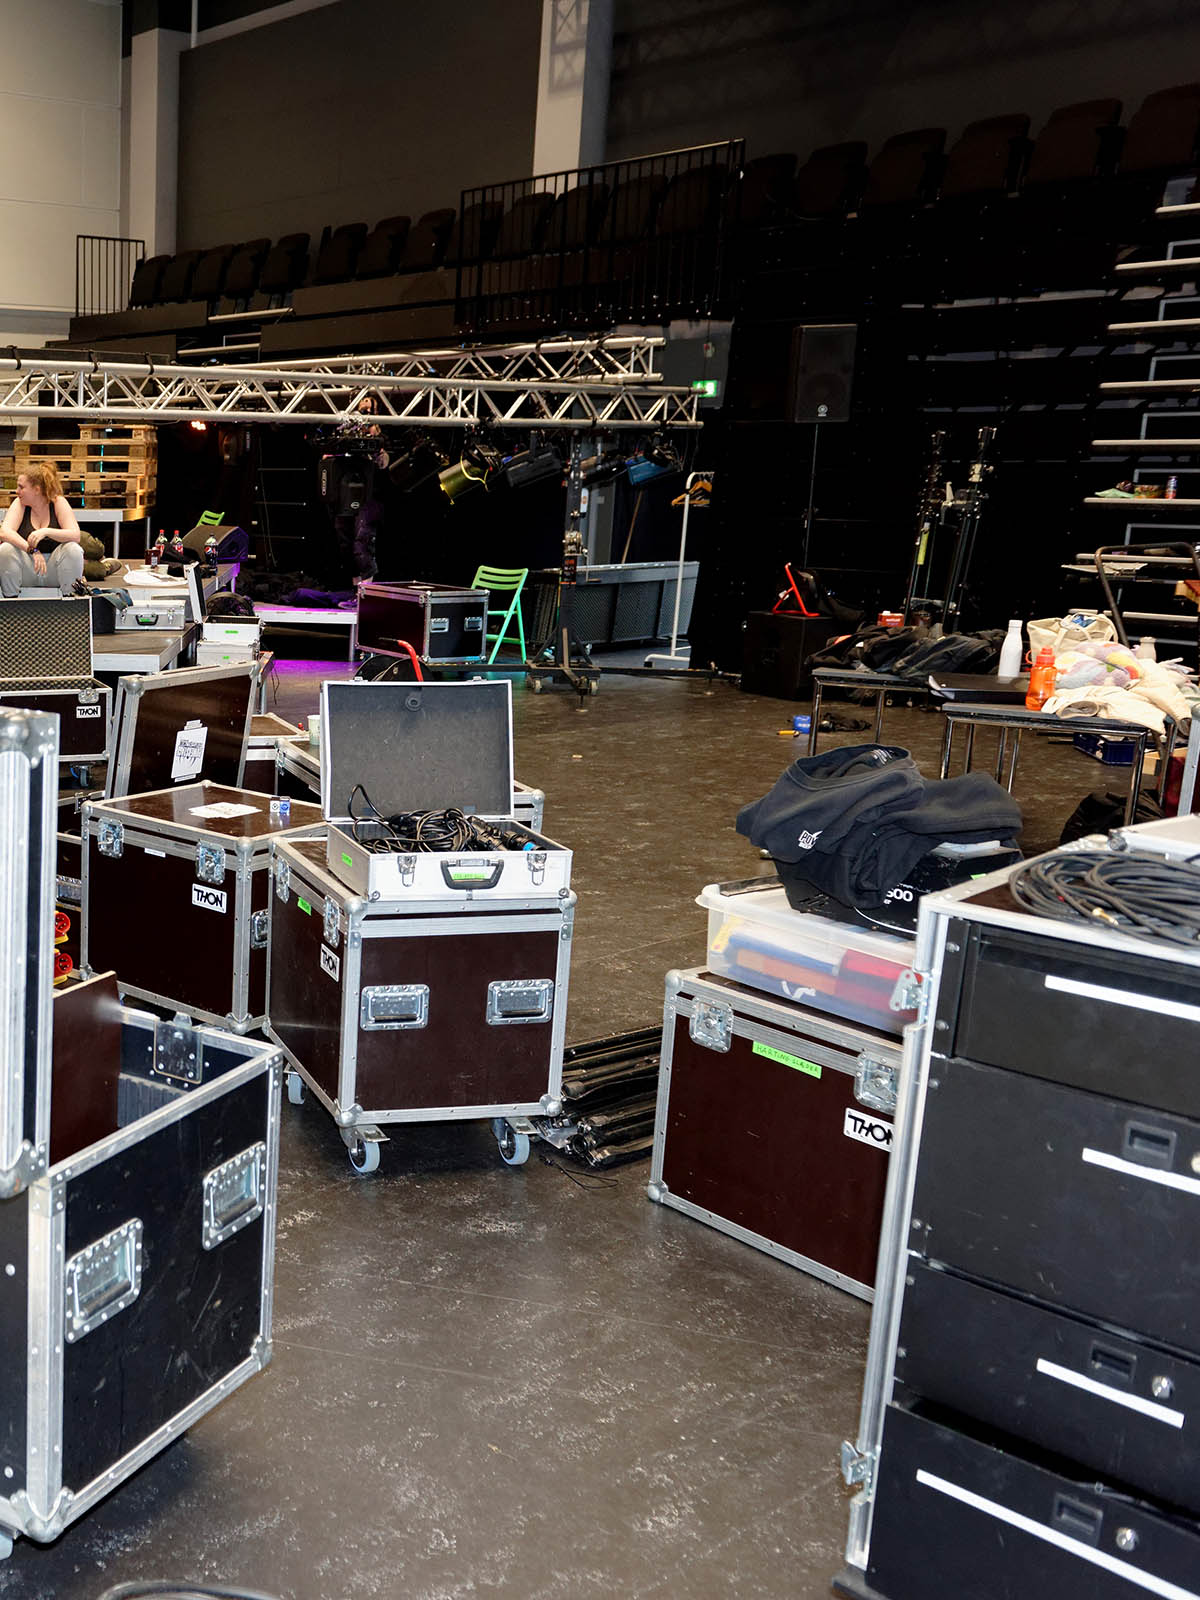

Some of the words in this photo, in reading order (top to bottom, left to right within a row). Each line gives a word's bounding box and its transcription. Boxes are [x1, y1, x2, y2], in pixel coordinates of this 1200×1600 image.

[77, 706, 99, 716] THON
[194, 887, 223, 908] THON
[321, 948, 337, 975] THON
